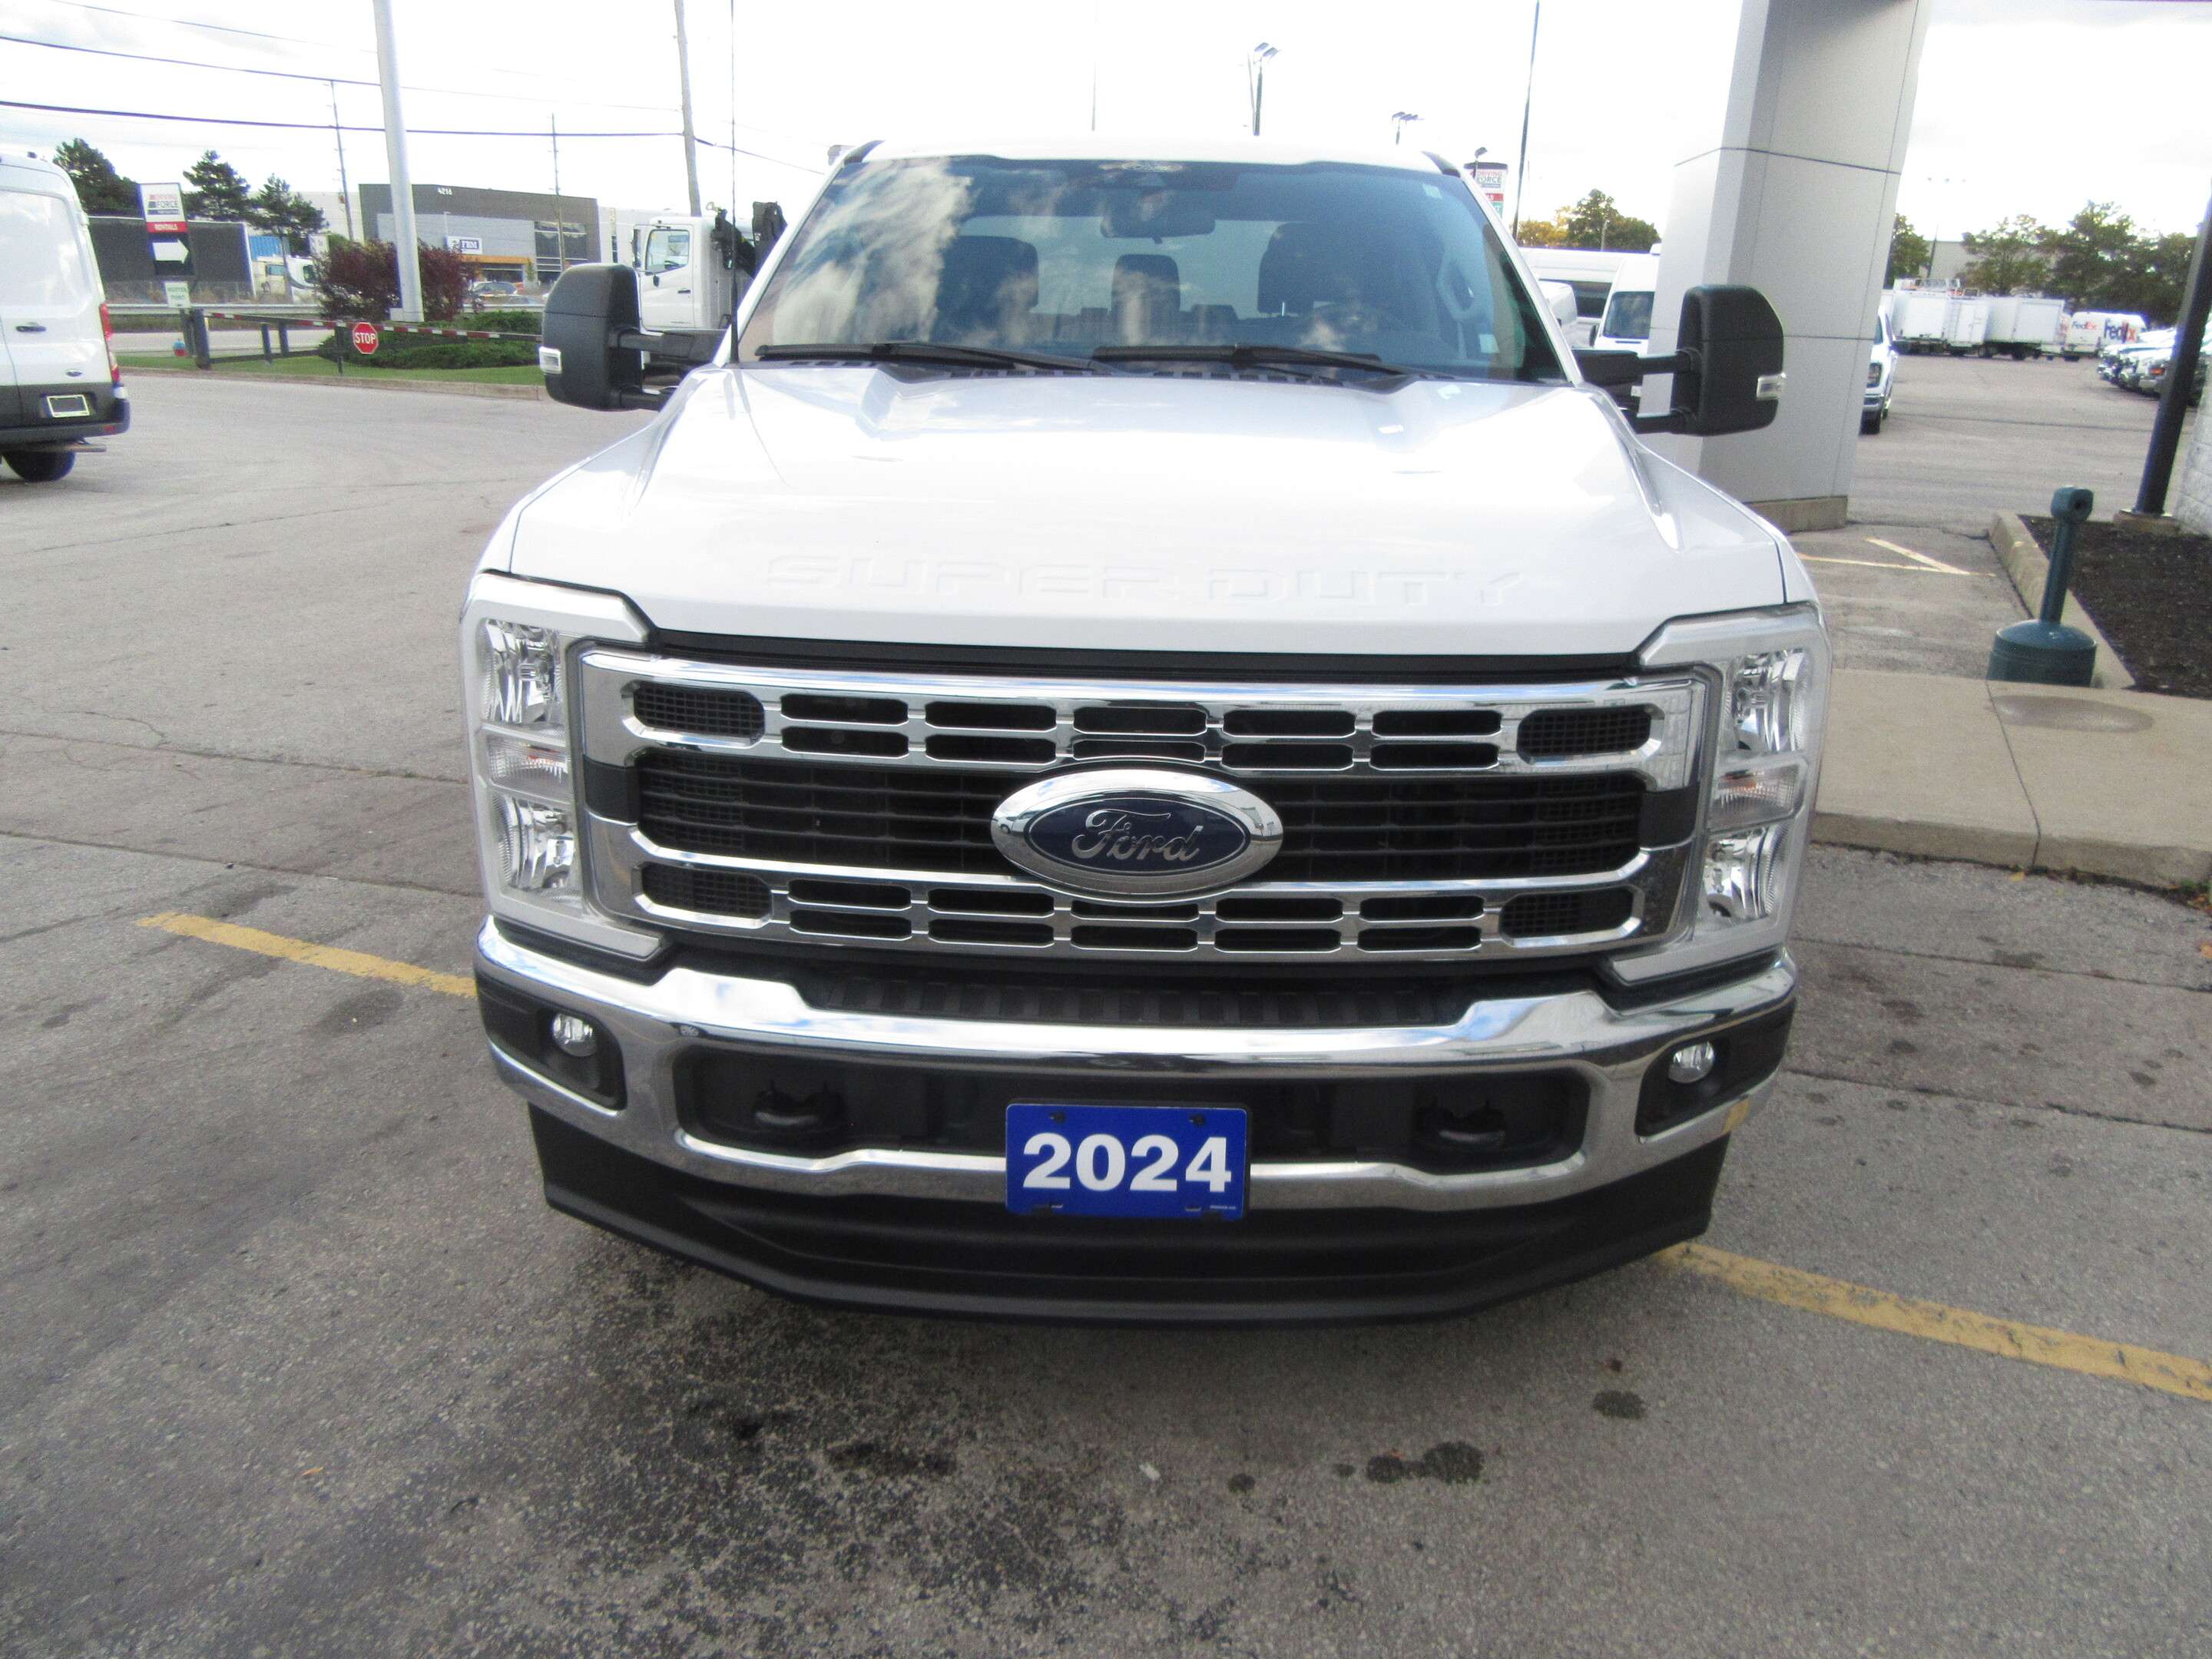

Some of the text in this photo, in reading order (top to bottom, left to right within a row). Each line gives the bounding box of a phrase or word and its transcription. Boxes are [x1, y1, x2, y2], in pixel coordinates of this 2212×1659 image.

[355, 332, 376, 344] STOP
[2104, 319, 2135, 343] FedEx
[767, 555, 1525, 607] SUPER DUTY
[1071, 809, 1204, 861] Ford
[1022, 1132, 1232, 1193] 2024
